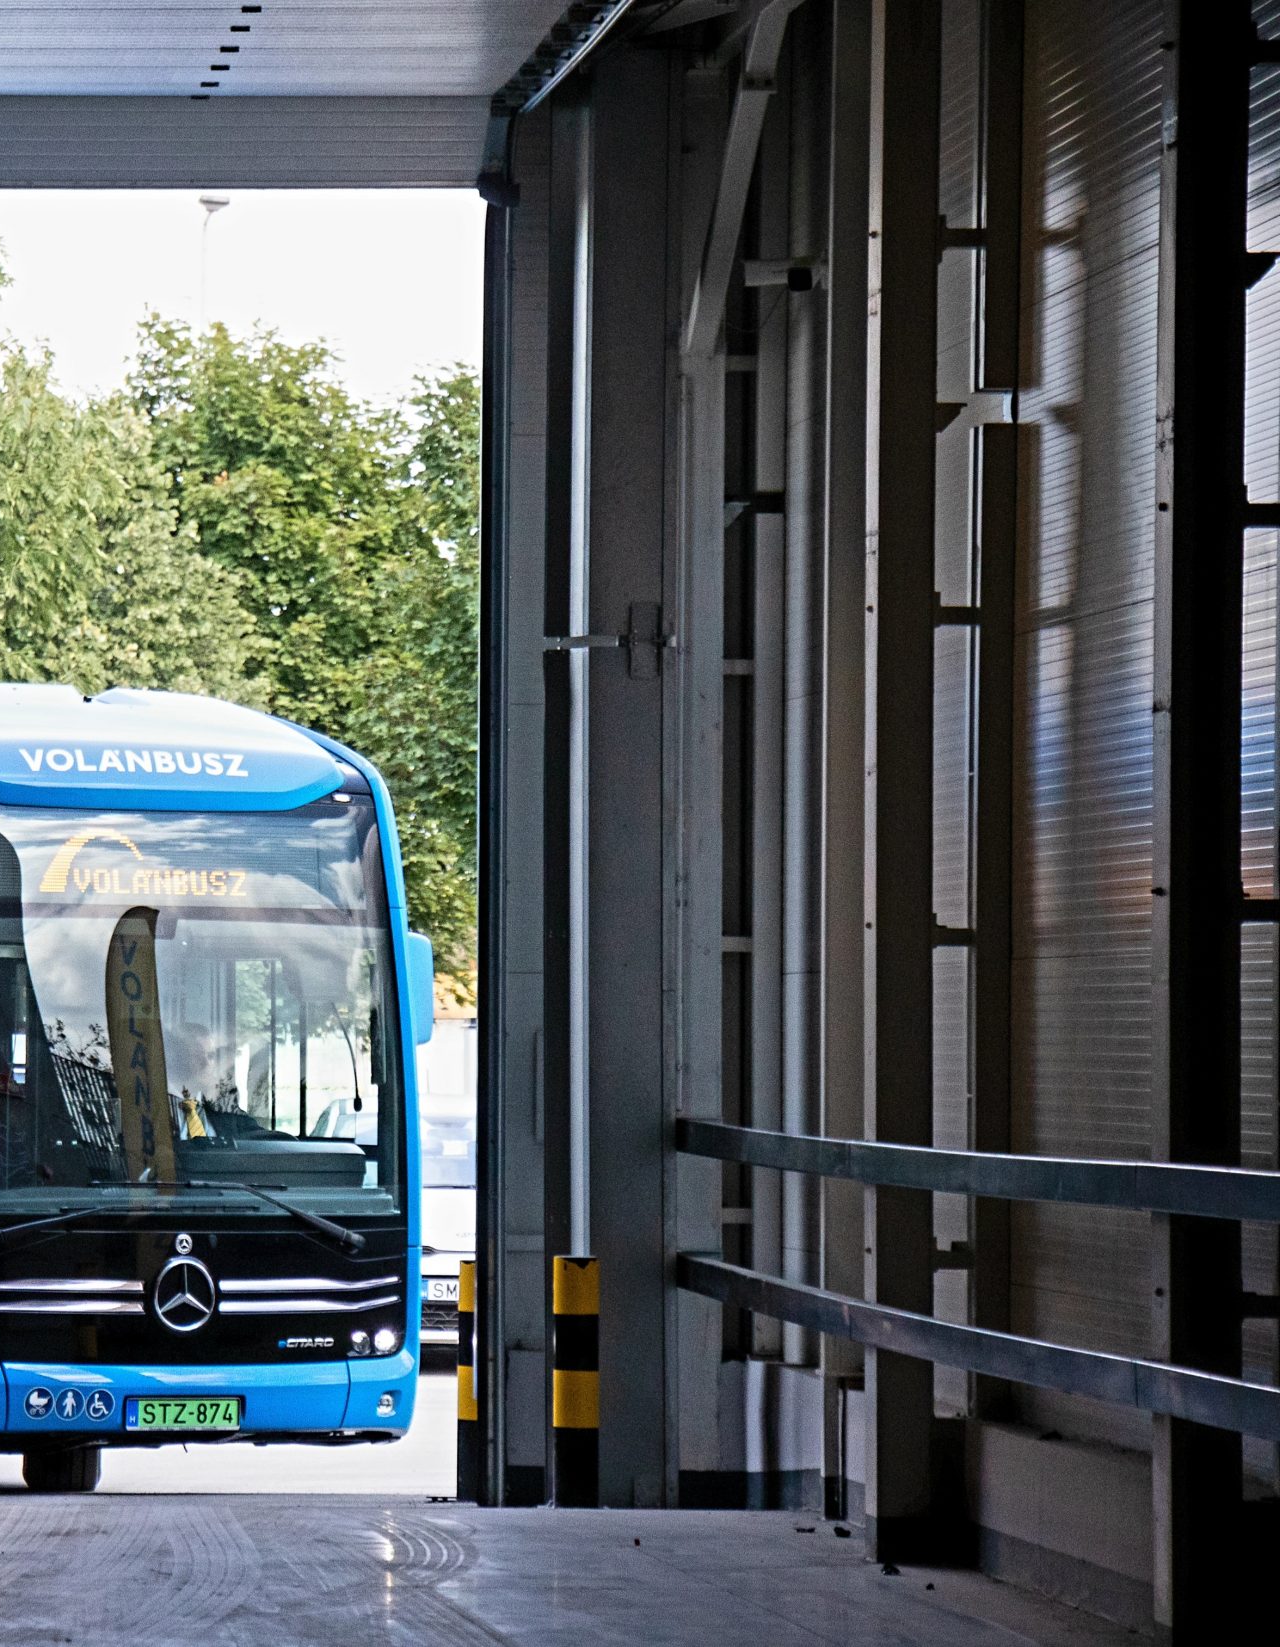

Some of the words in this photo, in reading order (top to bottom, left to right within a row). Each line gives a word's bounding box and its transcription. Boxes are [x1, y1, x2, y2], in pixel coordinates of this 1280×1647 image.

[19, 748, 249, 777] VOLÁNBUSZ
[73, 868, 248, 897] VOLÁNBUSZ
[433, 1282, 458, 1299] SM
[142, 1402, 233, 1424] STZ-874
